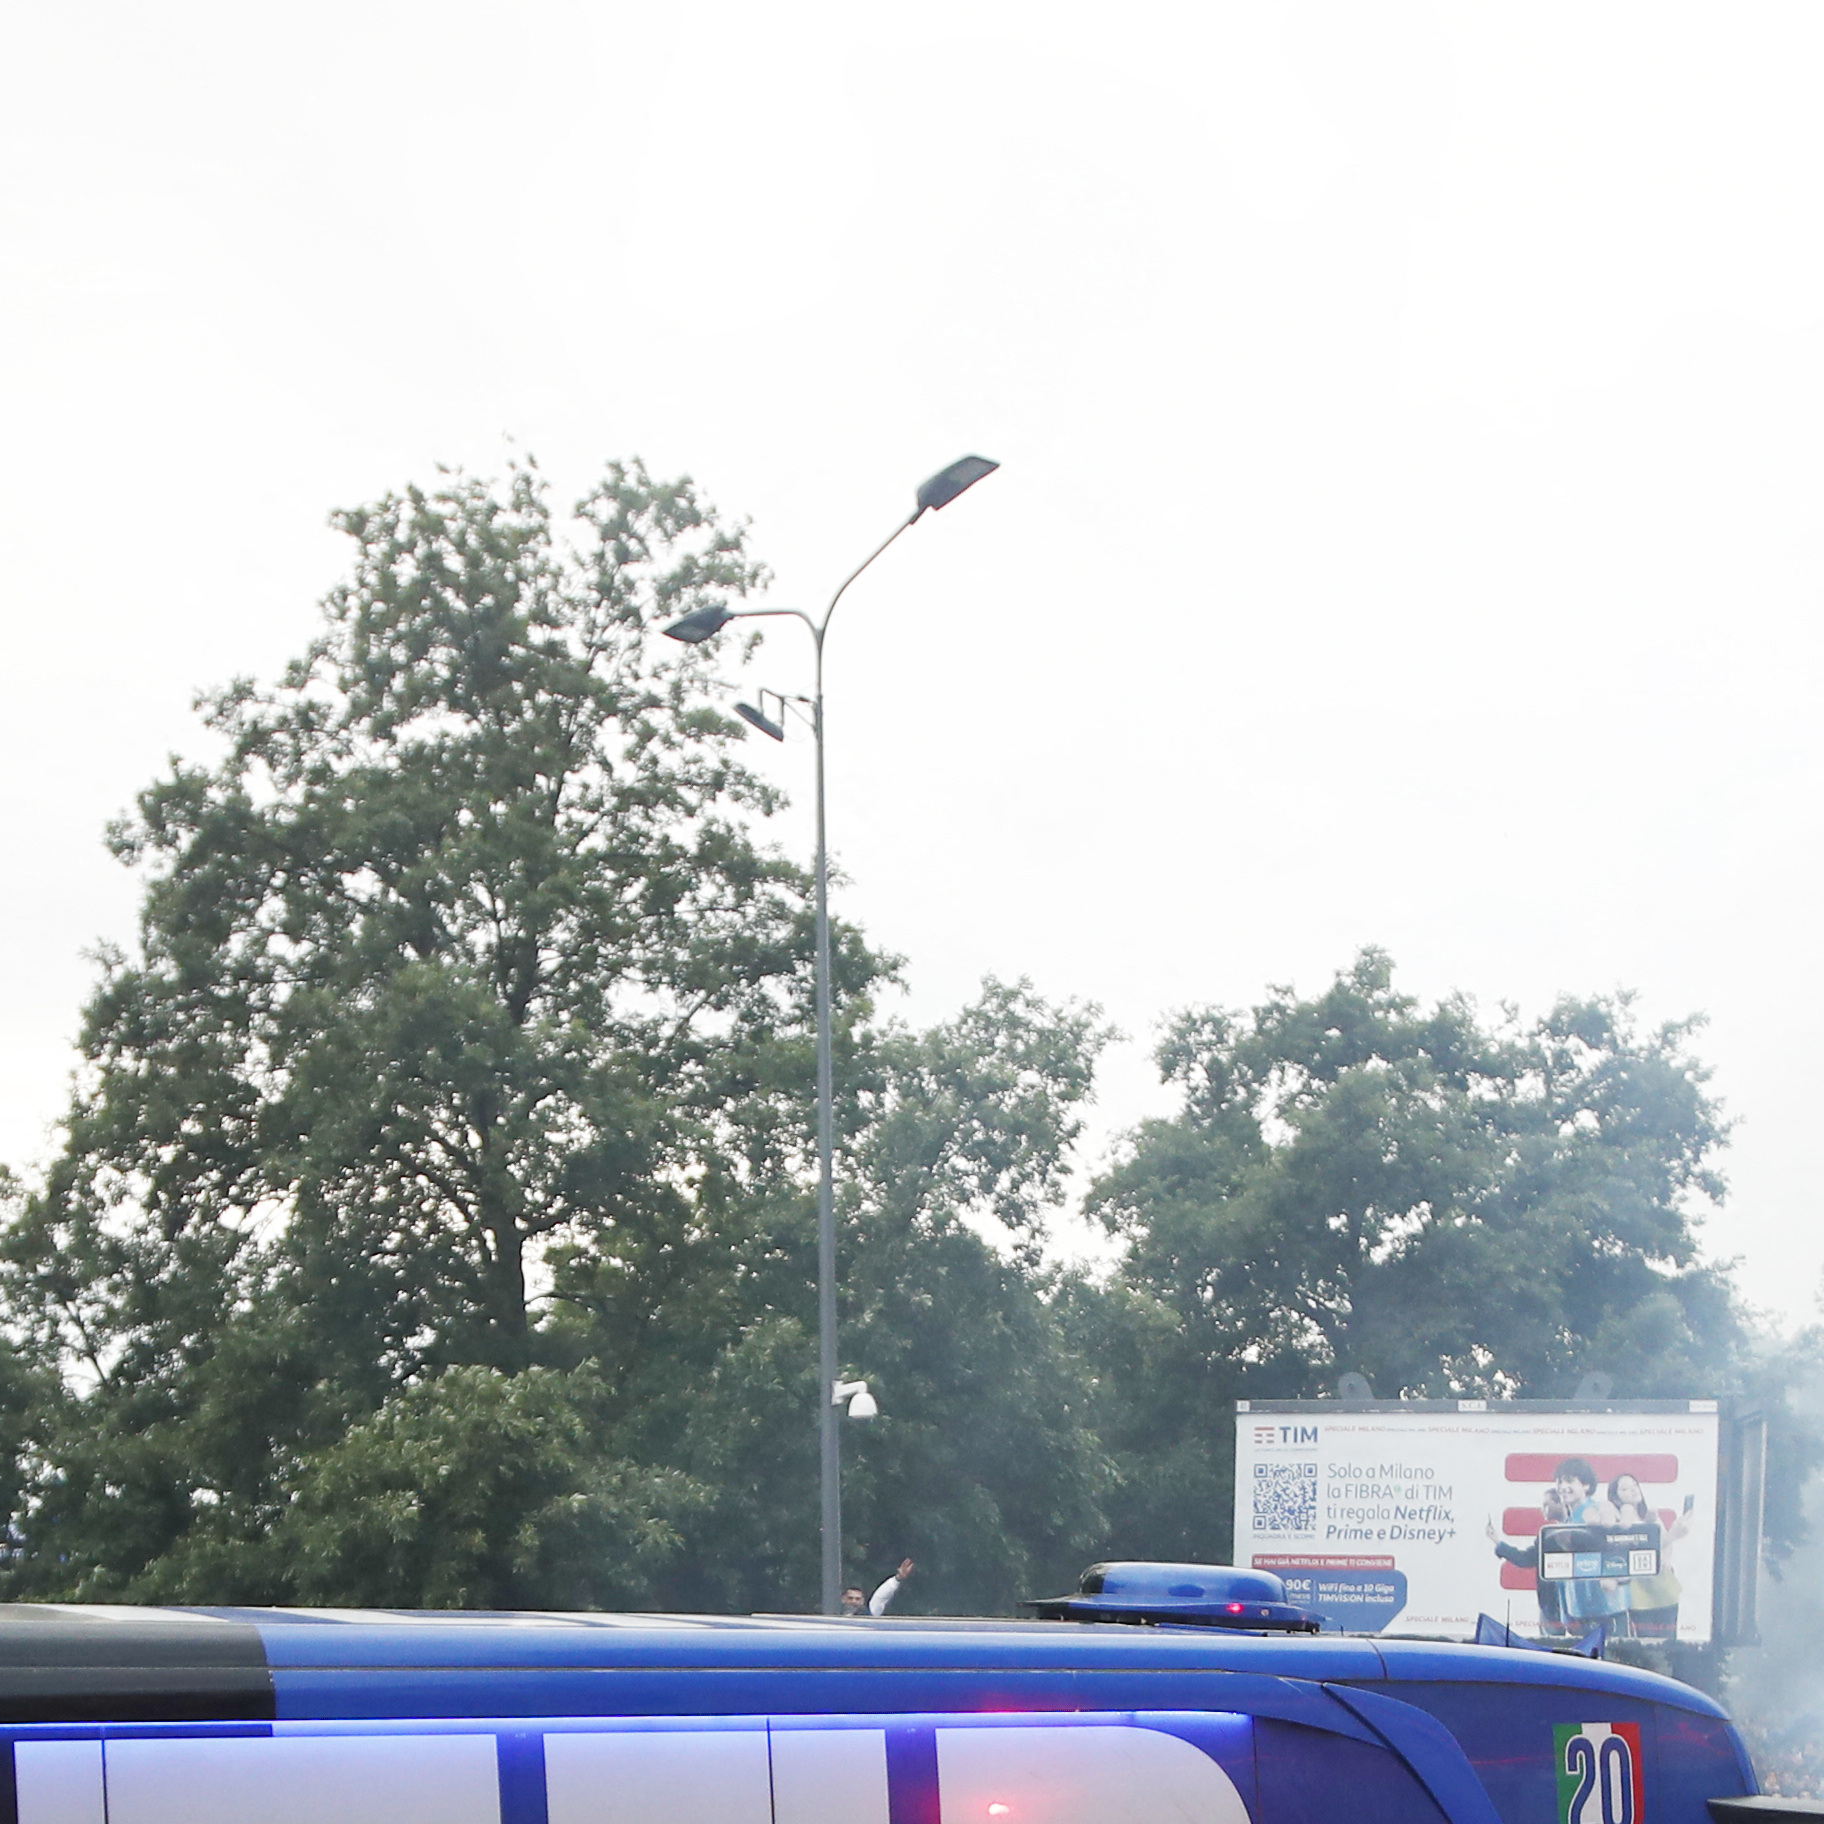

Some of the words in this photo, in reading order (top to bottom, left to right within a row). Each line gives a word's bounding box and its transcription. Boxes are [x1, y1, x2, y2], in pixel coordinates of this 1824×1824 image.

[1279, 1426, 1318, 1444] TIM
[1327, 1463, 1363, 1480] Solo
[1365, 1467, 1376, 1480] a
[1379, 1463, 1435, 1480] Milano
[1327, 1484, 1341, 1499] la
[1405, 1484, 1419, 1500] di
[1422, 1485, 1453, 1500] TIM
[1326, 1506, 1337, 1520] ti
[1340, 1506, 1390, 1524] regala
[1394, 1506, 1455, 1523] Netflix,
[1326, 1526, 1373, 1540] Prime
[1377, 1528, 1387, 1540] e
[1390, 1526, 1457, 1544] Disney+
[1290, 1558, 1319, 1566] NETFLIX
[1326, 1558, 1347, 1566] PRIME
[1356, 1558, 1393, 1567] CONVIENE
